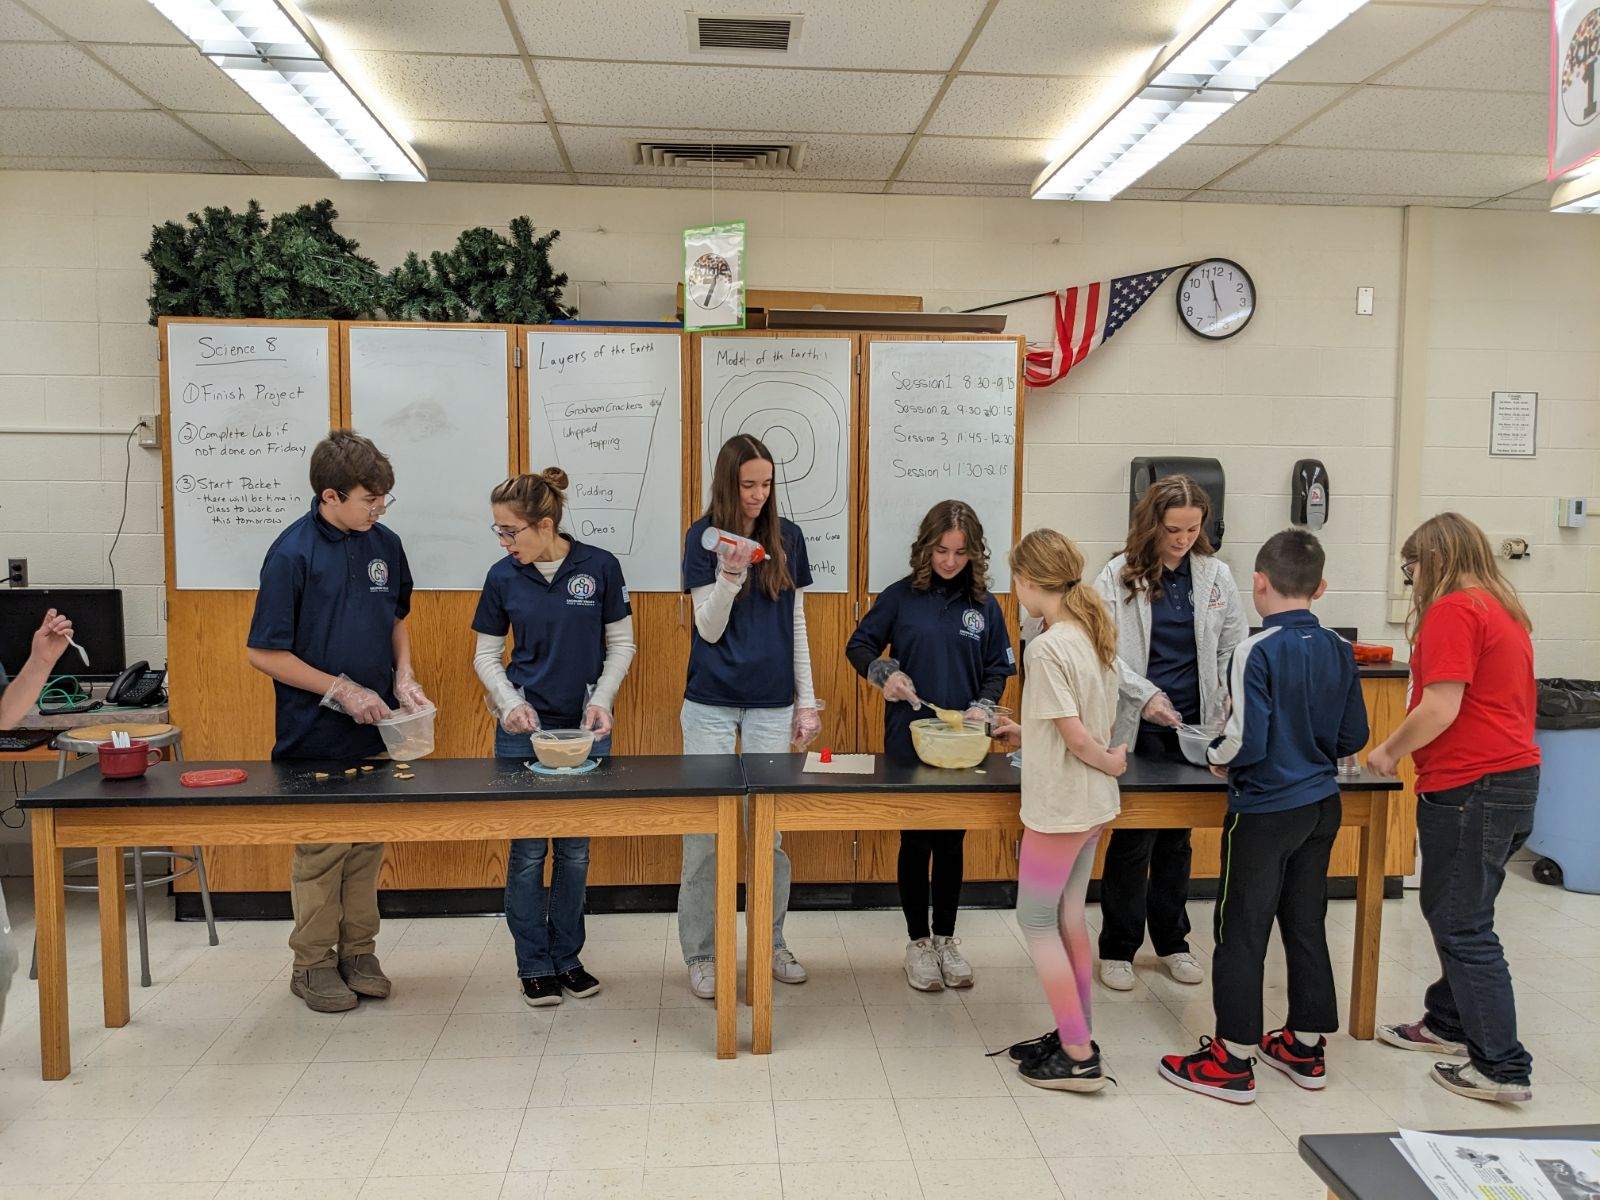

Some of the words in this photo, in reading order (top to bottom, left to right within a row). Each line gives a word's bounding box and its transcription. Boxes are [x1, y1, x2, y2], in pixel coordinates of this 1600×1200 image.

[1201, 269, 1210, 279] 11
[1212, 266, 1224, 276] 12
[1228, 271, 1233, 281] 1
[1189, 278, 1200, 288] 10
[1236, 283, 1244, 293] 2
[1183, 291, 1190, 302] 9
[1239, 297, 1246, 307] 3
[1186, 306, 1193, 316] 8
[1196, 317, 1203, 327] 7
[198, 336, 255, 359] Science
[265, 336, 278, 352] 8
[538, 341, 587, 374] Layers
[593, 345, 606, 357] of
[611, 344, 625, 356] the
[630, 342, 655, 354] Earth
[716, 350, 747, 367] Model
[756, 349, 768, 365] of
[773, 350, 783, 362] the
[891, 371, 945, 391] Session
[201, 383, 246, 402] Finish
[255, 384, 305, 407] Project
[564, 403, 604, 417] Graham
[605, 402, 643, 412] Crackers
[894, 400, 938, 414] Session
[940, 405, 950, 416] 2
[199, 425, 248, 442] Complete
[276, 422, 289, 437] if
[562, 422, 598, 439] Whipped
[893, 425, 935, 443] Session
[940, 432, 949, 446] 3
[195, 444, 216, 456] not
[220, 444, 246, 456] done
[249, 448, 262, 456] on
[267, 442, 307, 457] Friday
[588, 437, 621, 451] topping
[892, 459, 939, 478] Session
[943, 462, 951, 477] 4
[197, 477, 233, 490] Start
[229, 494, 248, 502] will
[251, 494, 263, 502] be
[266, 494, 286, 502] time
[575, 483, 613, 502] Pudding
[211, 516, 231, 524] this
[235, 516, 282, 524] tomorrow
[581, 519, 616, 536] Oreo's
[804, 535, 821, 543] nner
[825, 531, 840, 541] Core
[808, 560, 837, 576] antle
